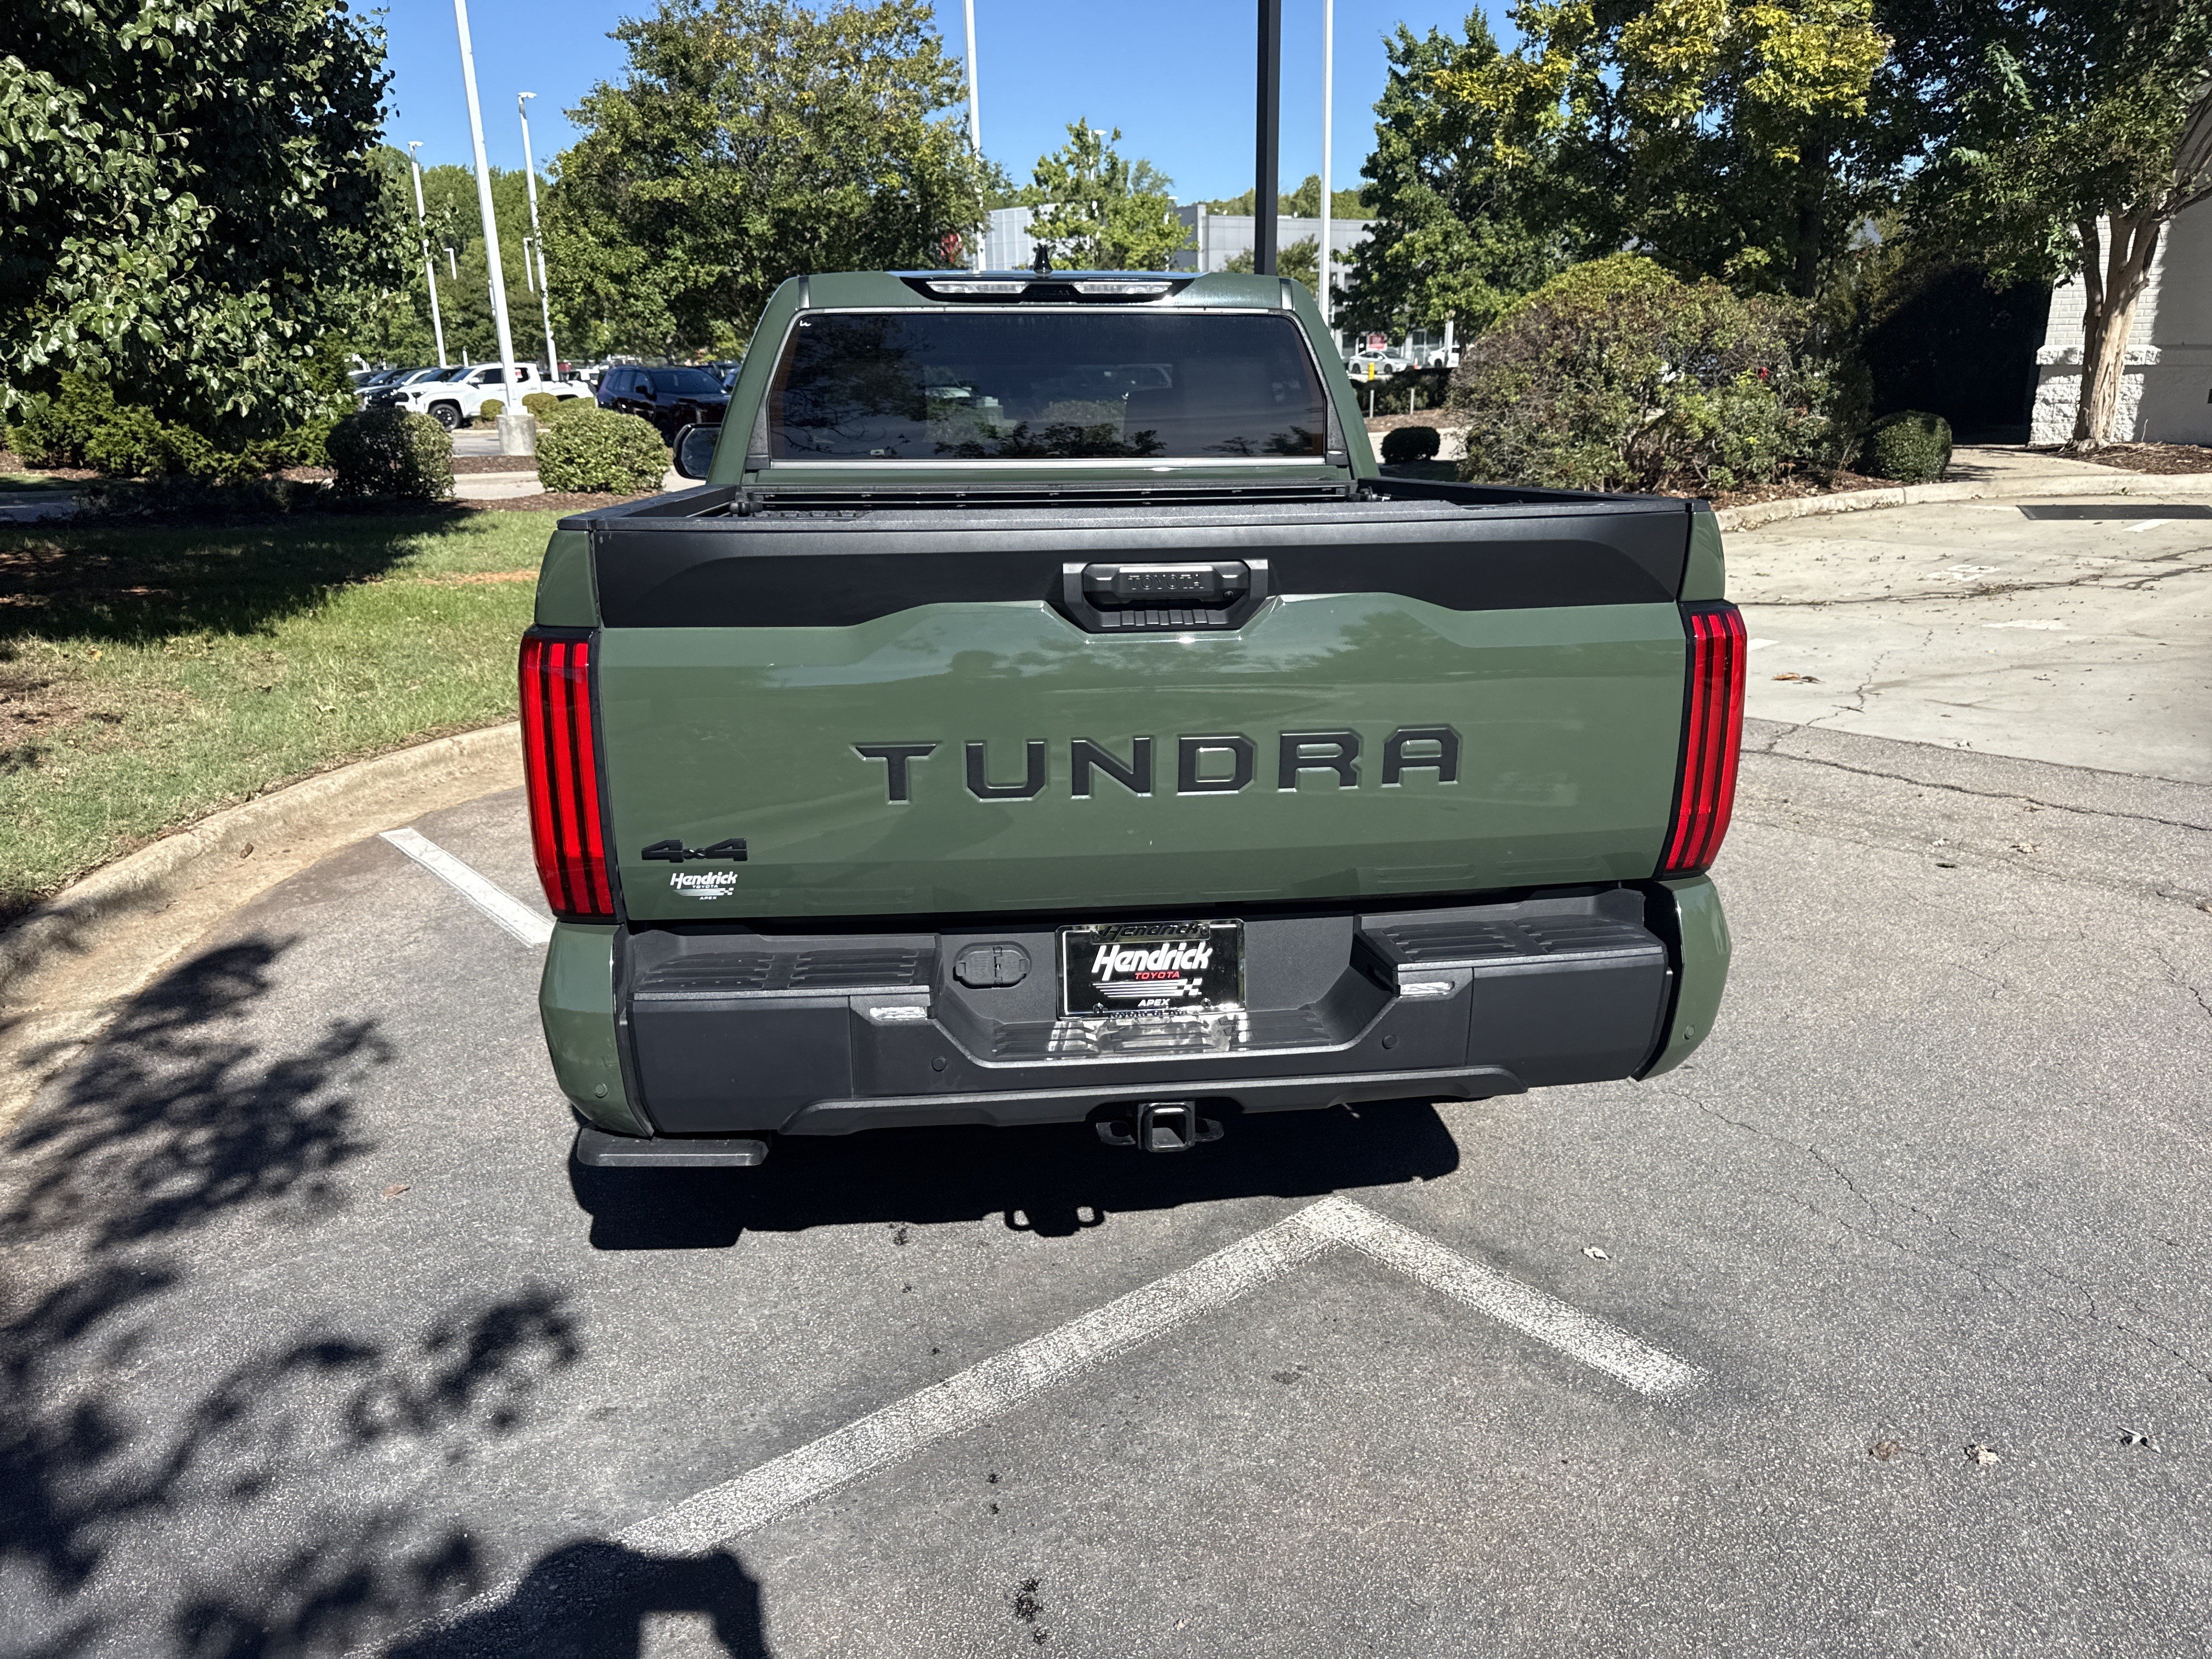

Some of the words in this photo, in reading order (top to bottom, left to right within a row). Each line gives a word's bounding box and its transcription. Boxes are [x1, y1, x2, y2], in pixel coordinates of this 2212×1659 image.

[1128, 573, 1204, 590] TOYOTA
[850, 724, 1462, 805] TUNDRA
[669, 871, 738, 889] Hendrick
[1099, 923, 1204, 941] Hendrick
[1091, 941, 1213, 981] Hendrick
[1134, 970, 1180, 980] TOYOTA
[1137, 998, 1171, 1007] APEX
